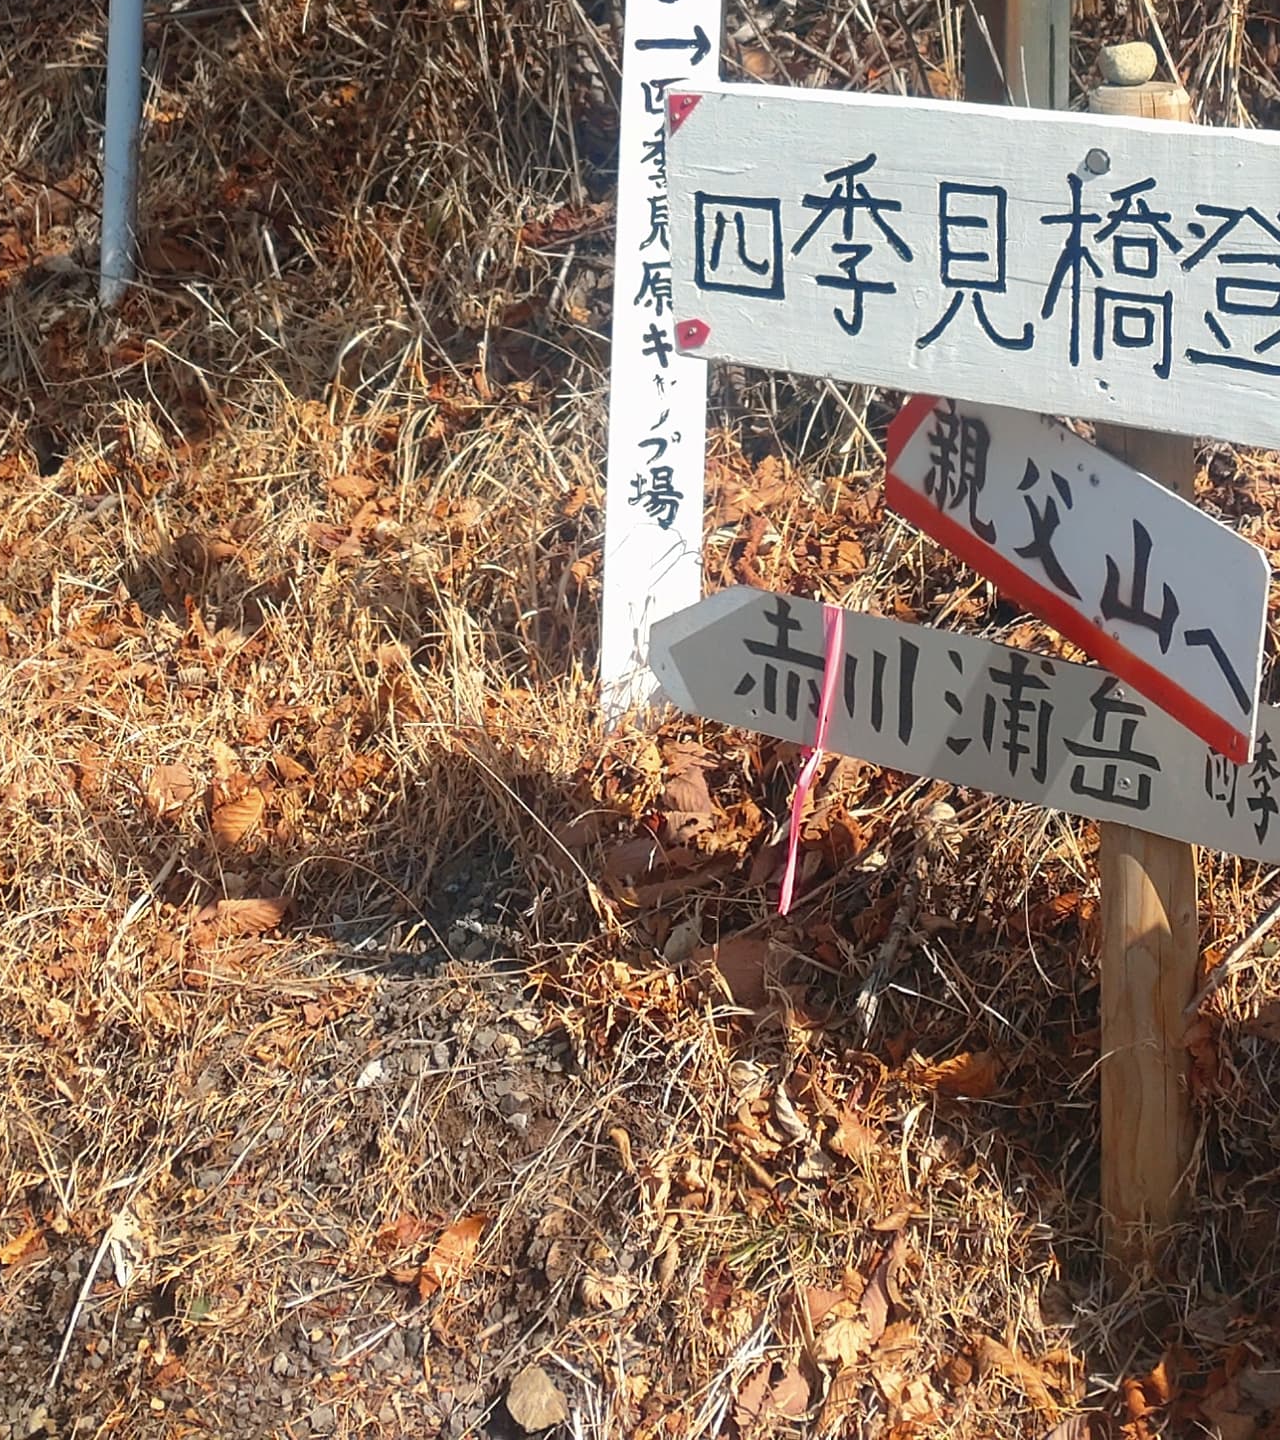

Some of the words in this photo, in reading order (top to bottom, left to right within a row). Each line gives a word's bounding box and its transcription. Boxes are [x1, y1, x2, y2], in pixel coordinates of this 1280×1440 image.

[923, 398, 1252, 716] 親父山へ
[733, 594, 1162, 812] 赤川浦岳
